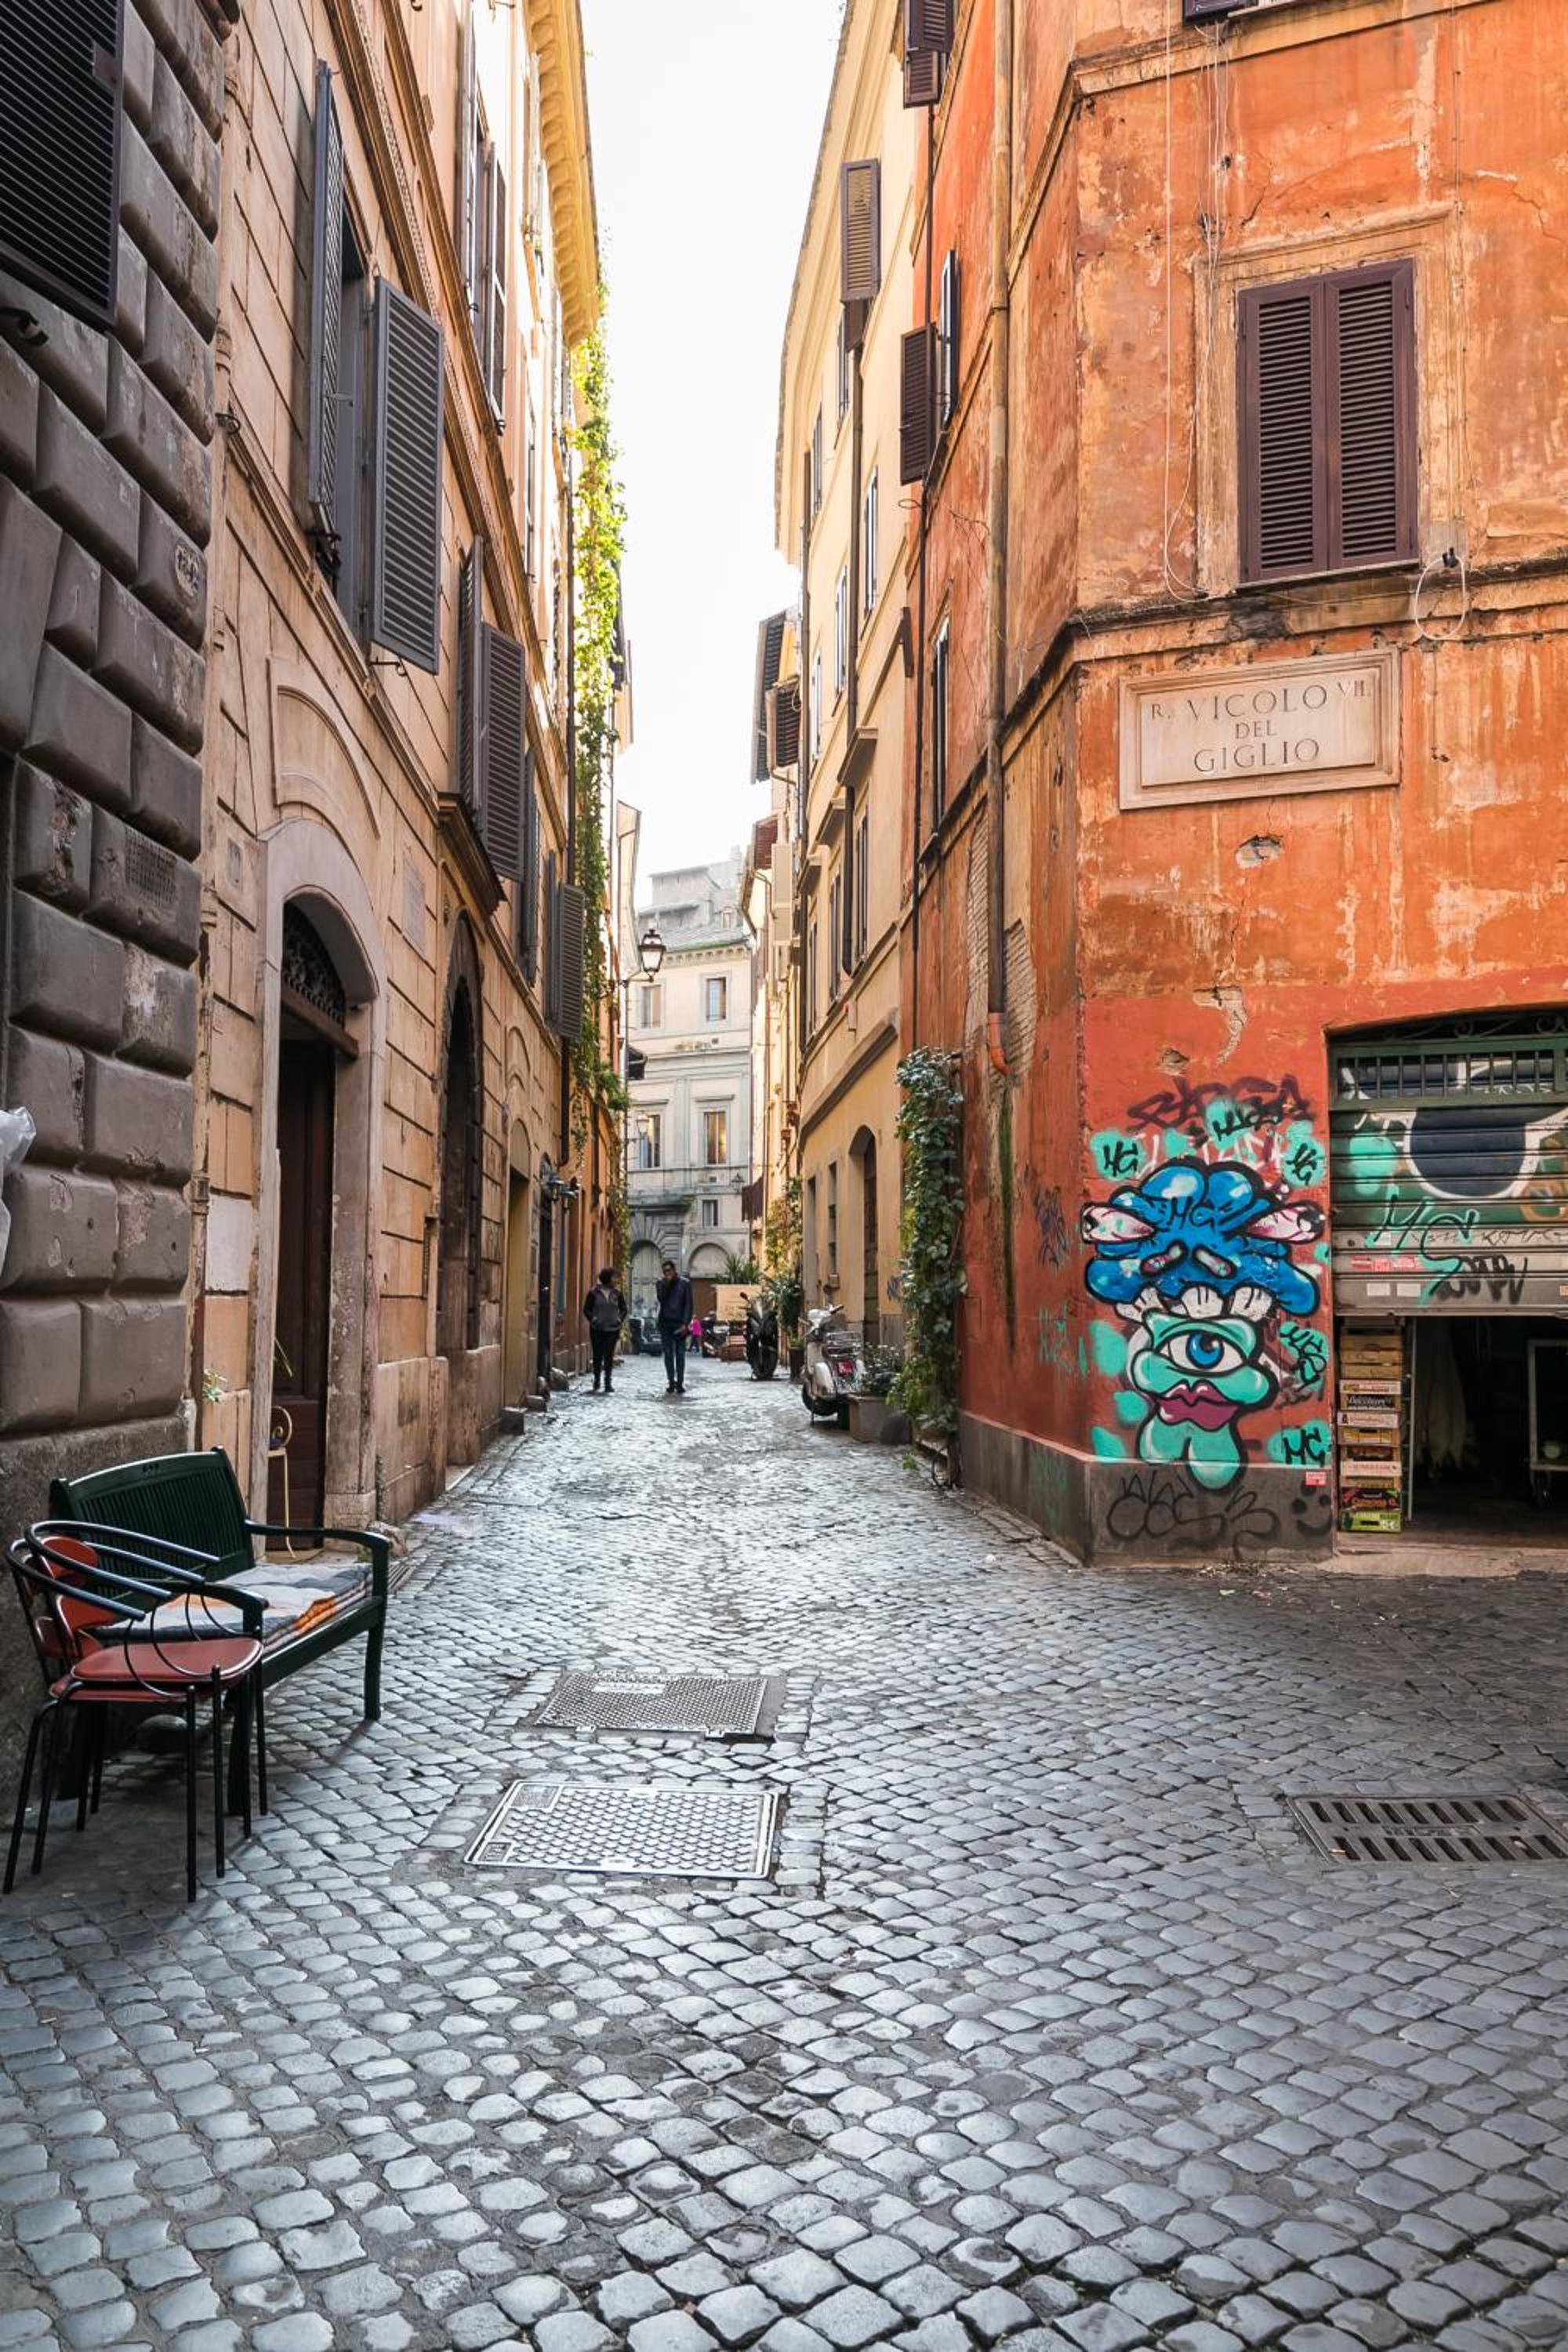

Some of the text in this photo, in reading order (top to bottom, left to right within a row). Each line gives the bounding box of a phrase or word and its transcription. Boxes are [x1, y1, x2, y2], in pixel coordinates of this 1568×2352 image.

[1151, 702, 1171, 720] R.
[1187, 684, 1328, 720] VICOLO
[1235, 719, 1277, 740] DEL
[1193, 738, 1320, 773] GIGLIO
